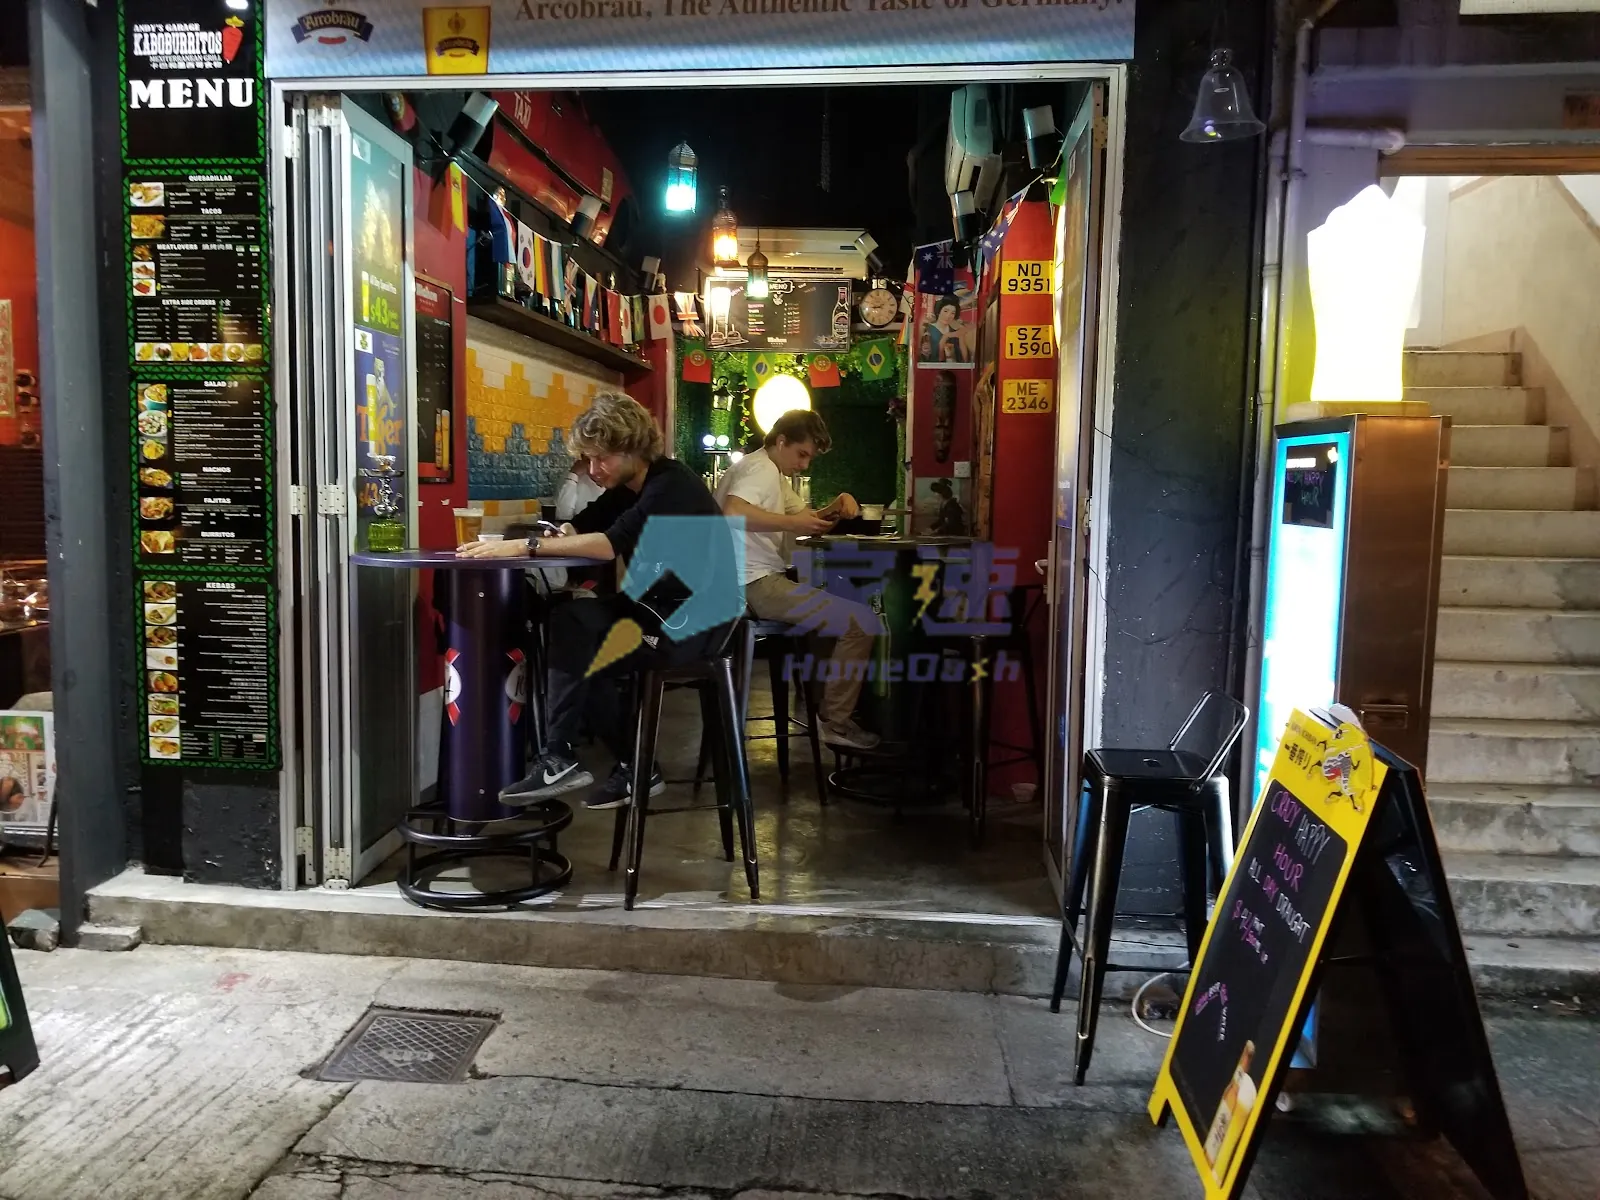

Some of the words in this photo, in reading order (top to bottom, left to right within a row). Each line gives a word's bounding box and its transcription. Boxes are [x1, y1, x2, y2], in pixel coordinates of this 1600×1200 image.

[664, 0, 711, 16] The
[165, 23, 200, 31] GARAGE
[133, 31, 222, 56] KABOBURRITOS
[129, 78, 254, 109] MENU
[514, 91, 531, 129] TAXI
[1017, 263, 1041, 277] ND
[1008, 278, 1051, 292] 9351
[1017, 327, 1041, 341] SZ
[1009, 342, 1051, 356] 1590
[1016, 382, 1039, 396] ME
[1006, 397, 1049, 410] 2346
[357, 404, 403, 456] Tger
[1270, 790, 1301, 828] CRAZY
[1294, 814, 1331, 865] HAPPY
[1273, 843, 1304, 892] HOUR
[1248, 857, 1262, 884] ALL
[1262, 875, 1279, 903] DAY
[1275, 892, 1311, 943] DRAUGHT
